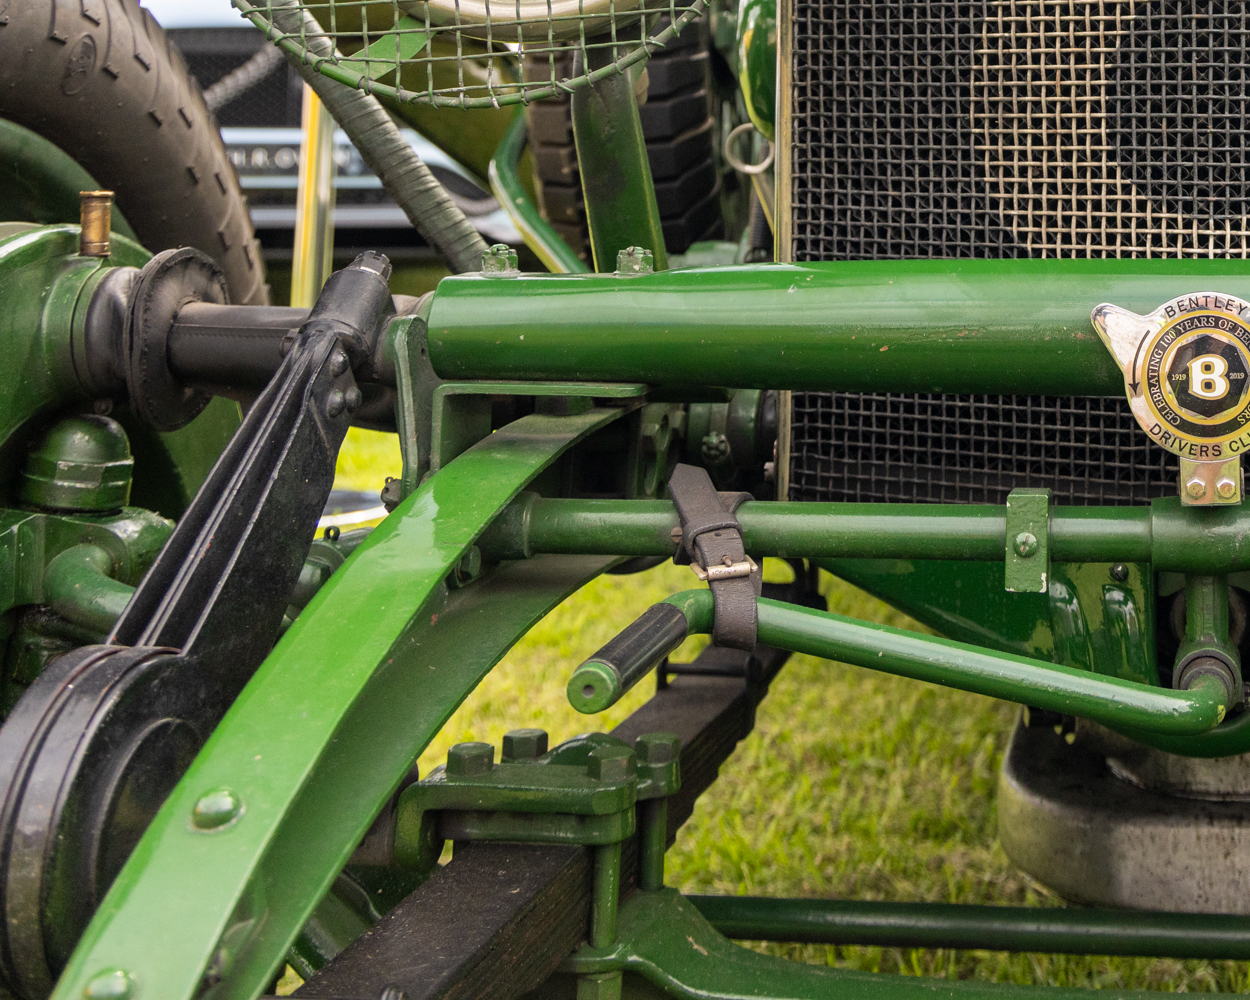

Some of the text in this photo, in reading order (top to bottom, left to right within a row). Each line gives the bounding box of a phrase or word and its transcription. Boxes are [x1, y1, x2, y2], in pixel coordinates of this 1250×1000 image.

[1164, 295, 1248, 318] BENTLEY
[1176, 317, 1216, 334] YEARS
[1218, 319, 1235, 331] OF
[1160, 329, 1178, 348] 100
[1171, 373, 1187, 381] 1919
[1187, 354, 1231, 400] B
[1229, 372, 1245, 380] 2019
[1148, 347, 1181, 426] CELEBRATING
[1149, 423, 1222, 458] DRIVERS
